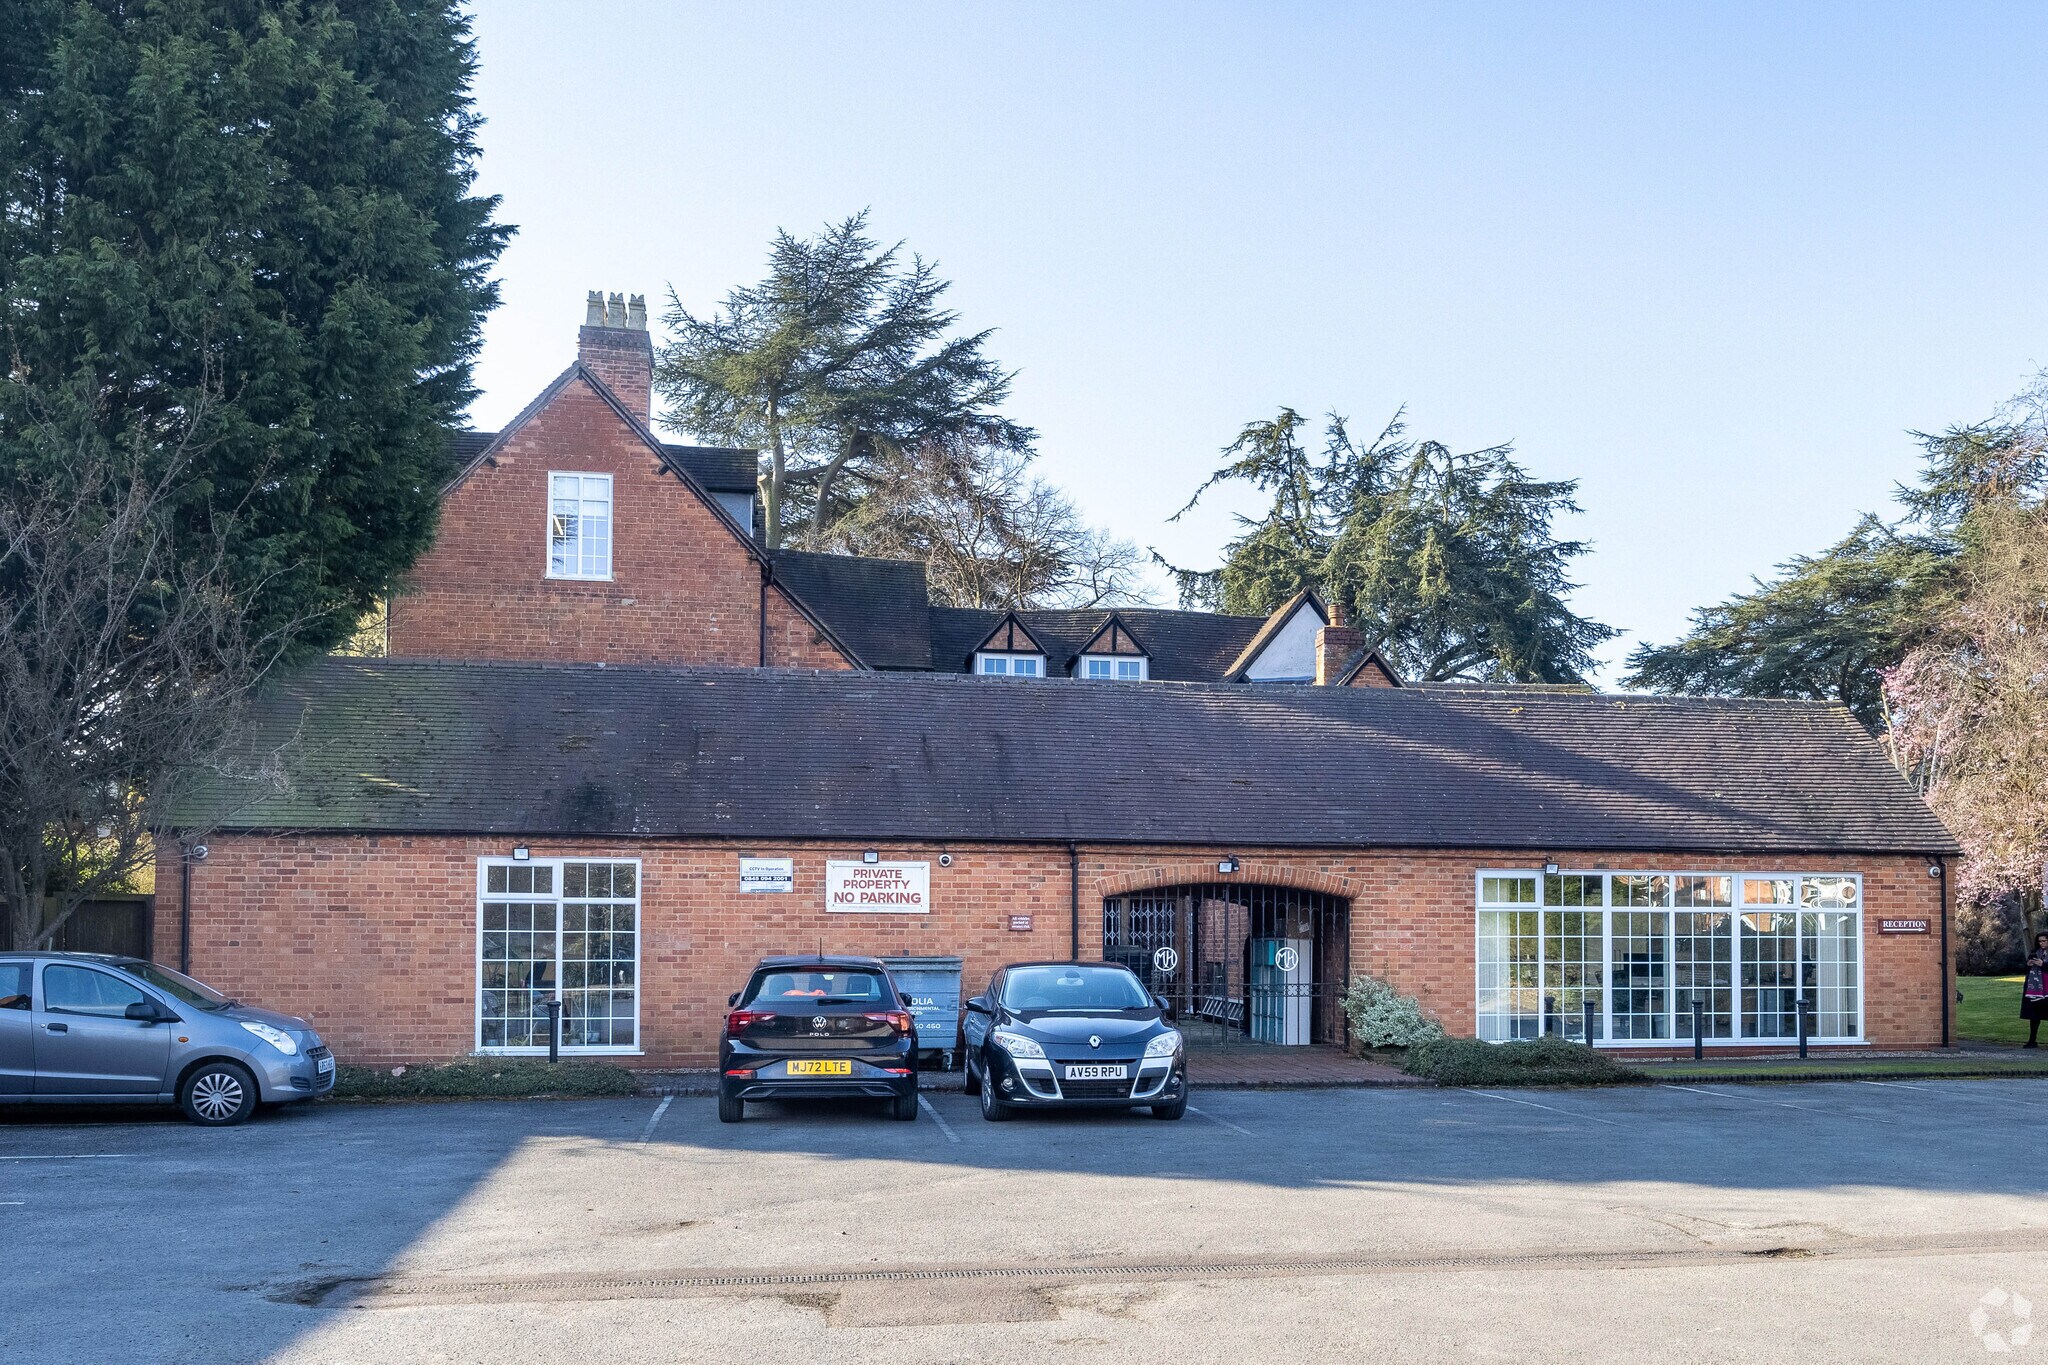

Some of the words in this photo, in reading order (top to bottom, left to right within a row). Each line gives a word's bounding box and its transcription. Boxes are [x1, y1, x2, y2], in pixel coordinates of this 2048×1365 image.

[853, 869, 903, 879] PRIVATE
[843, 879, 911, 889] PROPERTY
[833, 891, 855, 903] NO
[860, 892, 922, 904] PARKING
[1882, 920, 1927, 928] RECEPTION
[911, 997, 934, 1005] OLIA
[792, 1061, 822, 1072] MJ72
[825, 1061, 847, 1072] LTE
[1070, 1066, 1099, 1078] AV59
[1101, 1066, 1122, 1078] RPU
